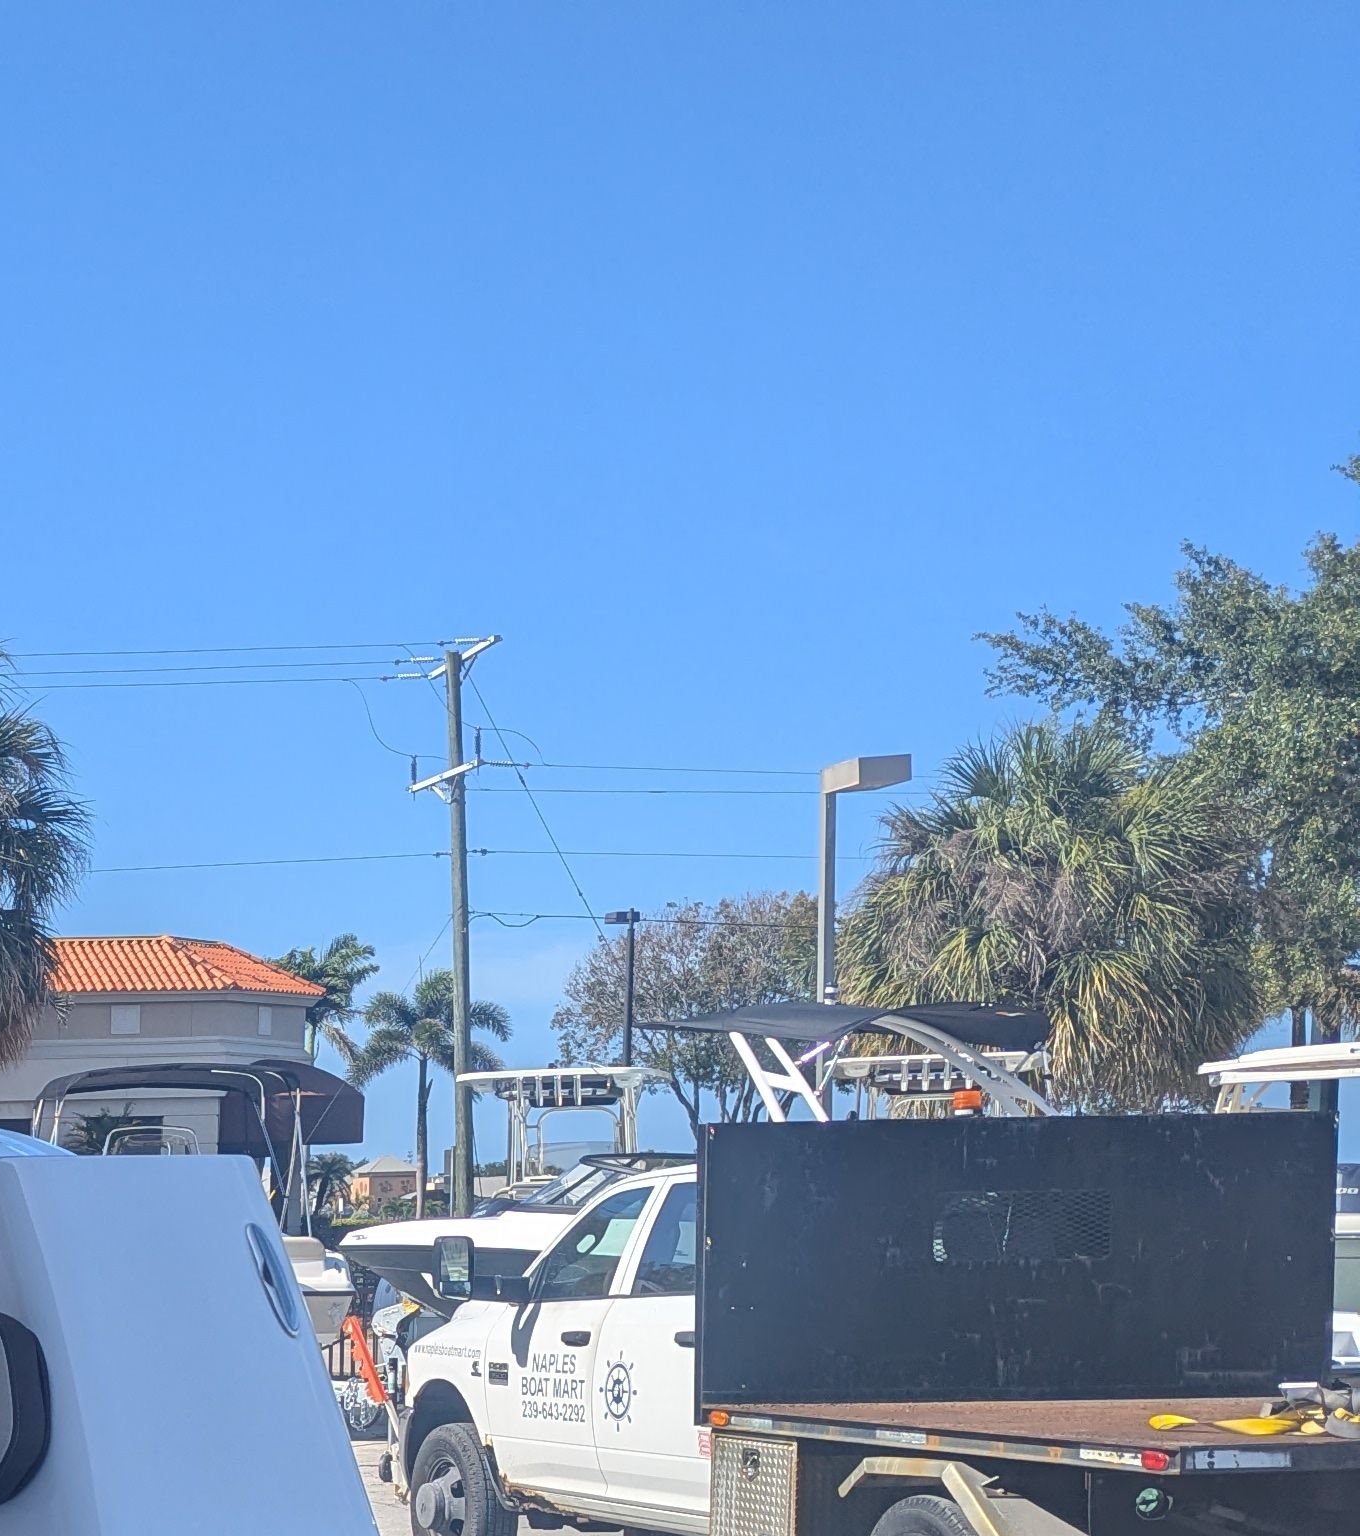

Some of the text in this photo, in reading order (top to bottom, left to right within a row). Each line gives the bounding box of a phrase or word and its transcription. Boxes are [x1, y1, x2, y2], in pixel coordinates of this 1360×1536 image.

[532, 1353, 577, 1375] NAPLES
[521, 1377, 586, 1400] BOAT MART
[521, 1400, 586, 1423] 239-643-2292
